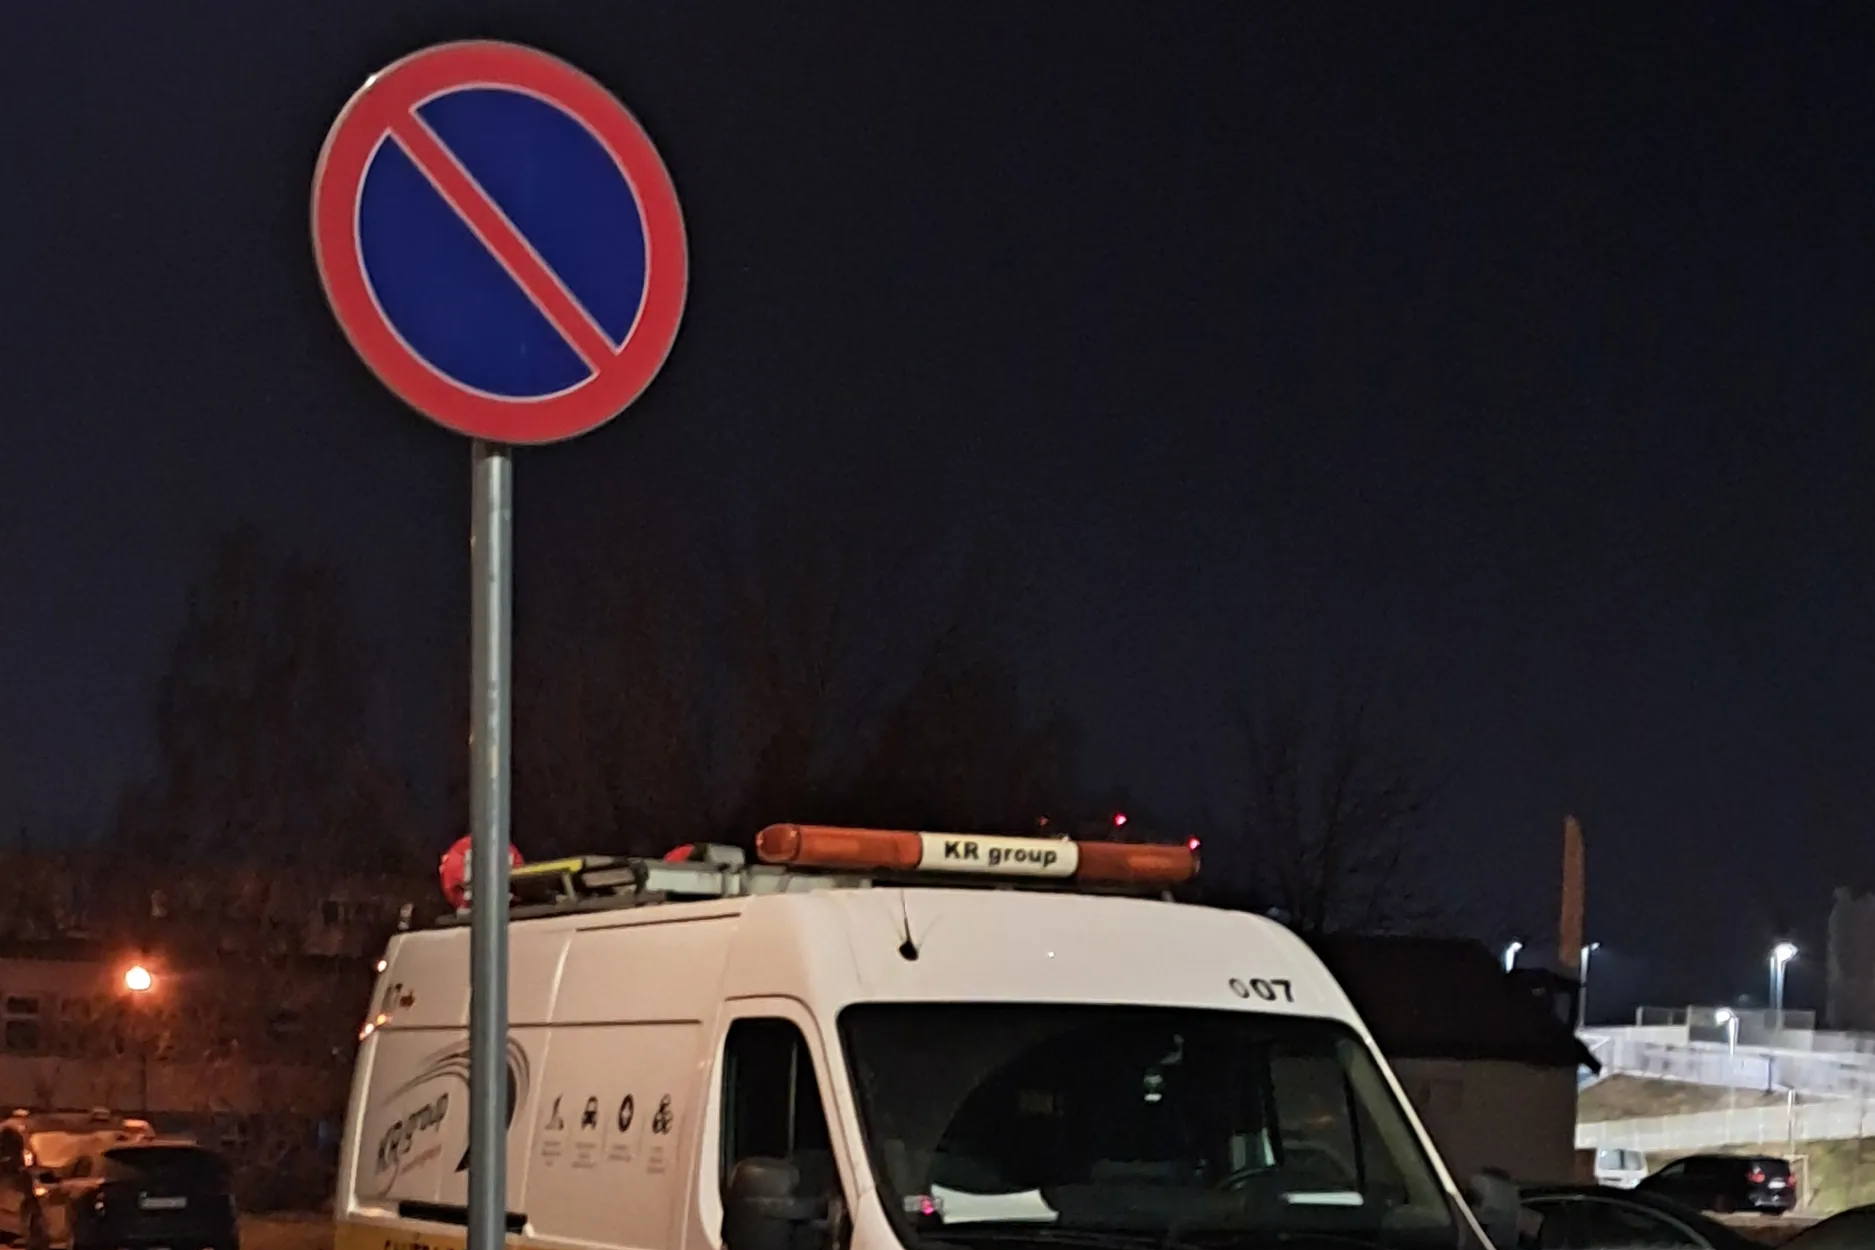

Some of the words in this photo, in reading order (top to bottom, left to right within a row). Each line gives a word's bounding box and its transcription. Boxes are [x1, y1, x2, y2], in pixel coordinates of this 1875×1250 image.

[944, 840, 979, 860] KR
[987, 847, 1057, 867] group
[1228, 977, 1295, 1003] 007
